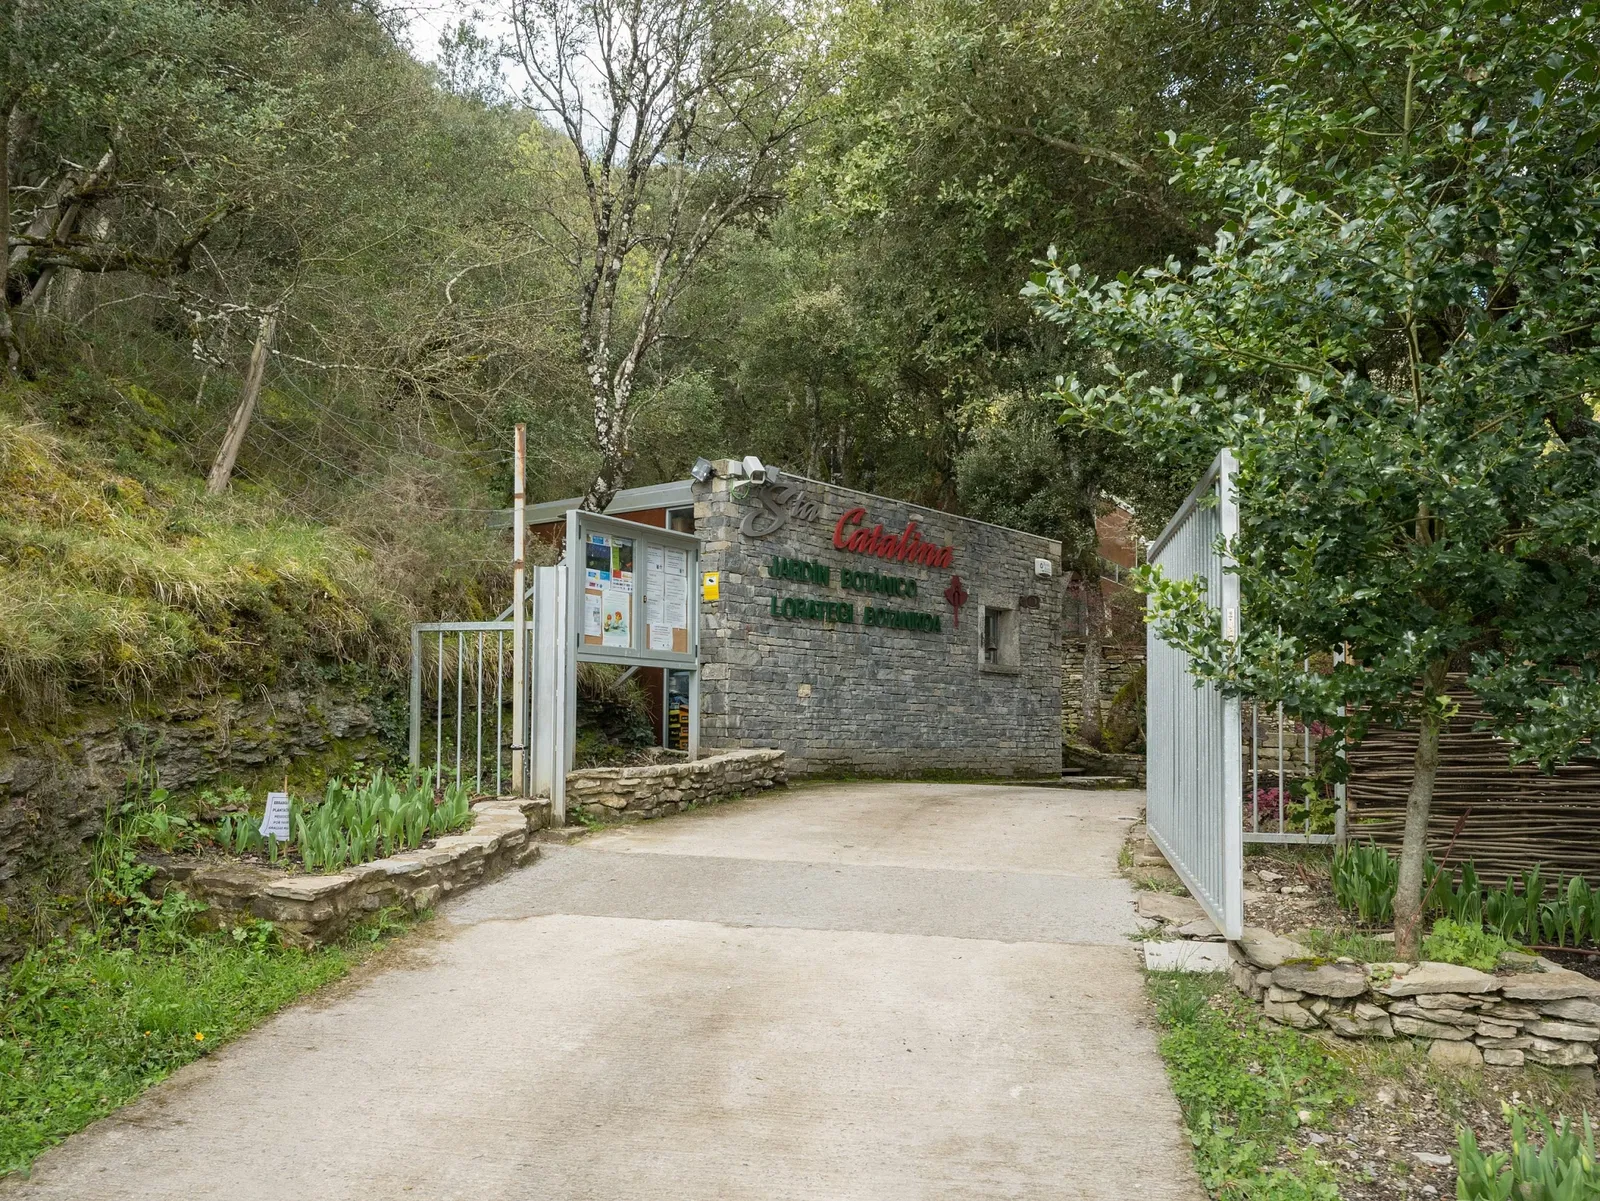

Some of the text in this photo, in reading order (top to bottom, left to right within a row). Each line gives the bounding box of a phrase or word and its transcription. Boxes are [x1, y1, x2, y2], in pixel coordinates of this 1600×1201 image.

[739, 482, 954, 569] Sta Catalina
[768, 554, 830, 586] JARDÍN
[771, 594, 941, 633] LORATEGI BOTANIKOA
